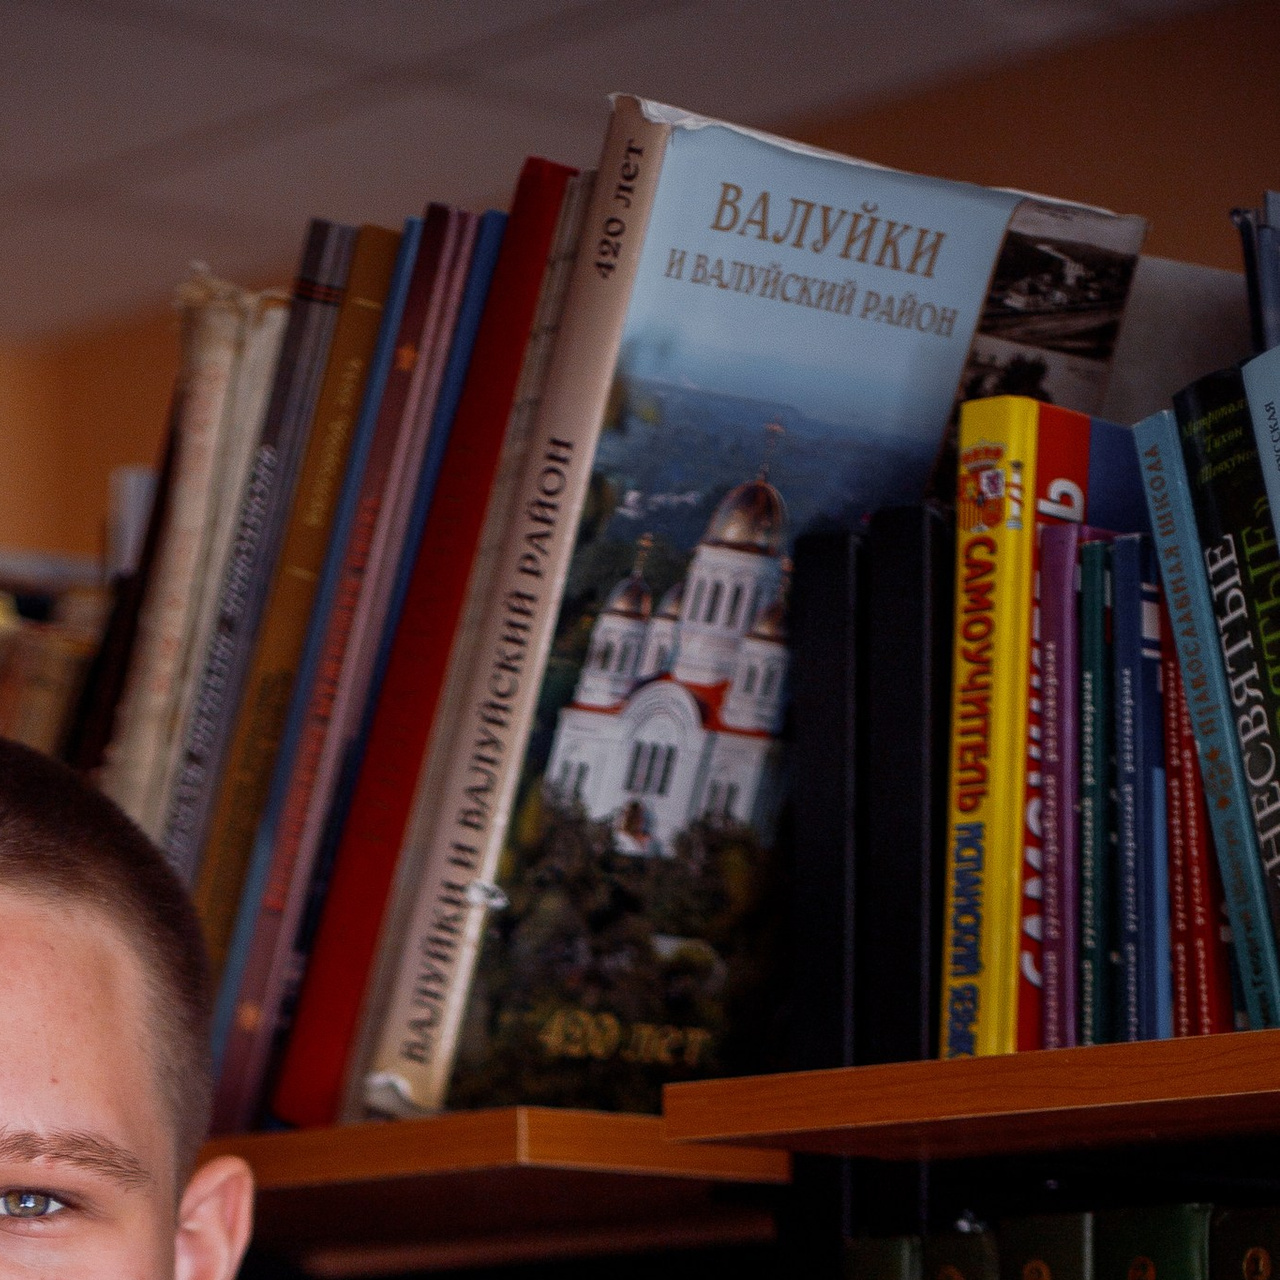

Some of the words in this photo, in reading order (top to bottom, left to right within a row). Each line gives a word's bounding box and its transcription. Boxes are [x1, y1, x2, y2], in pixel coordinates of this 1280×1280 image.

[595, 217, 627, 280] 420
[614, 139, 645, 209] лет
[710, 181, 948, 281] ВАЛУЙКИ
[664, 248, 684, 280] И
[690, 253, 858, 316] ВАЛУЙСКИЙ
[862, 289, 959, 339] РАЙОН
[521, 436, 575, 581] РАЙОН
[1144, 444, 1175, 537] ШКОЛА
[457, 592, 539, 832] ВАЛУЙСКИЙ
[956, 536, 996, 812] САМОУЧИТЕЛЬ
[447, 836, 475, 869] И
[402, 873, 475, 1065] ВАЛУЙКИ
